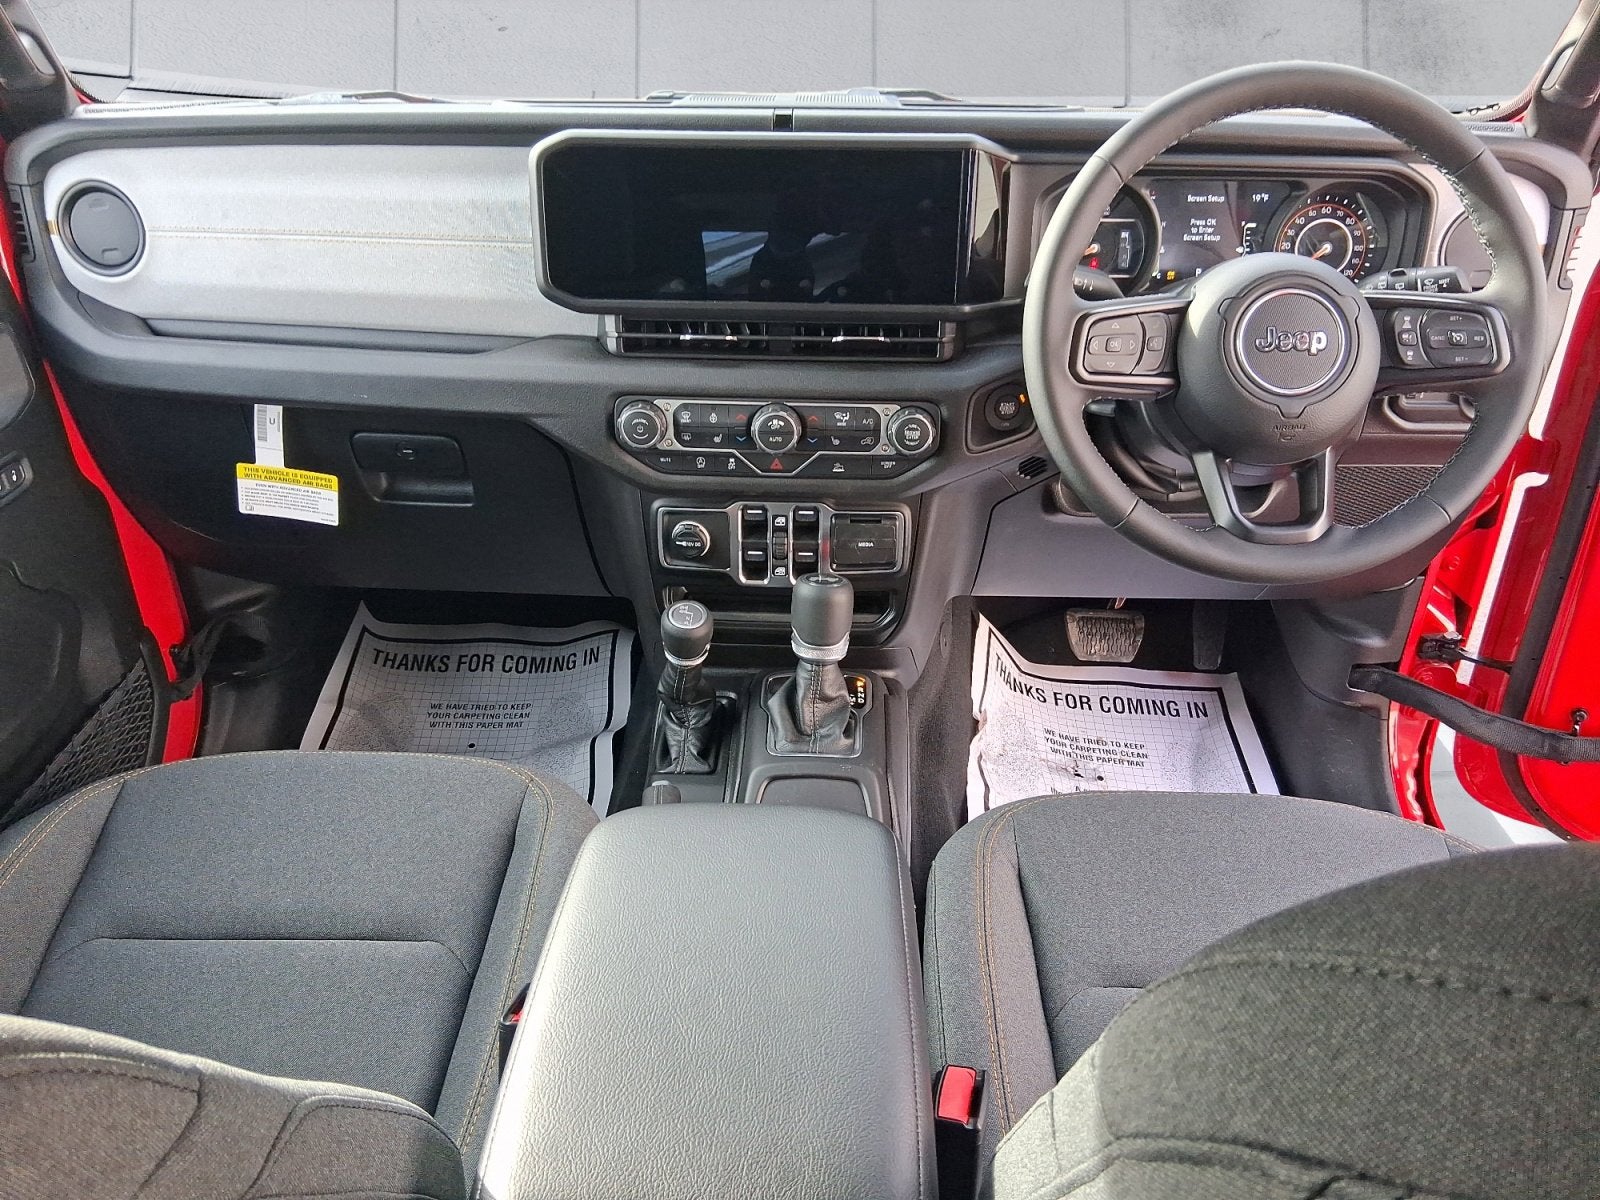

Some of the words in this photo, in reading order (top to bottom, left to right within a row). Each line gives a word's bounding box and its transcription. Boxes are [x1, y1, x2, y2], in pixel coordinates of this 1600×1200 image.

[1187, 194, 1207, 203] Screen
[1207, 194, 1225, 204] Setup
[1321, 206, 1332, 214] 60
[1295, 216, 1305, 225] 40
[1203, 234, 1221, 242] Setup
[1281, 242, 1291, 250] 20
[1255, 325, 1329, 357] Jeep
[269, 417, 276, 426] U
[243, 466, 260, 474] THIS
[261, 467, 290, 477] VEHICLE
[300, 472, 333, 484] EQUIPPED
[263, 475, 301, 484] ADVANCED
[315, 481, 333, 489] BAGS
[372, 647, 450, 673] THANKS
[456, 653, 494, 673] FOR
[501, 652, 577, 674] COMING
[583, 645, 600, 666] IN
[994, 652, 1048, 704] THANKS
[1053, 690, 1093, 712] FOR
[1099, 695, 1181, 718] COMING
[1187, 701, 1209, 719] IN
[430, 702, 443, 710] WE
[445, 702, 469, 711] HAVE
[469, 703, 496, 711] TRIED
[497, 703, 509, 711] TO
[509, 702, 532, 711] KEEP
[427, 711, 451, 720] YOUR
[453, 711, 500, 720] CARPETING
[503, 711, 530, 720] CLEAN
[429, 721, 453, 729] WITH
[453, 721, 474, 729] THIS
[476, 721, 503, 729] PAPER
[505, 720, 525, 729] MAT
[1043, 727, 1056, 737] WE
[1058, 732, 1081, 743] HAVE
[1082, 737, 1108, 747] TRIED
[1110, 740, 1122, 748] TO
[1123, 741, 1146, 750] KEEP
[1044, 736, 1068, 749] YOUR
[1069, 744, 1118, 756] CARPETING
[1120, 750, 1149, 760] CLEAN
[1050, 746, 1073, 759] WITH
[1074, 751, 1094, 762] THIS
[1096, 756, 1126, 766] PAPER
[1126, 759, 1145, 768] MAT
